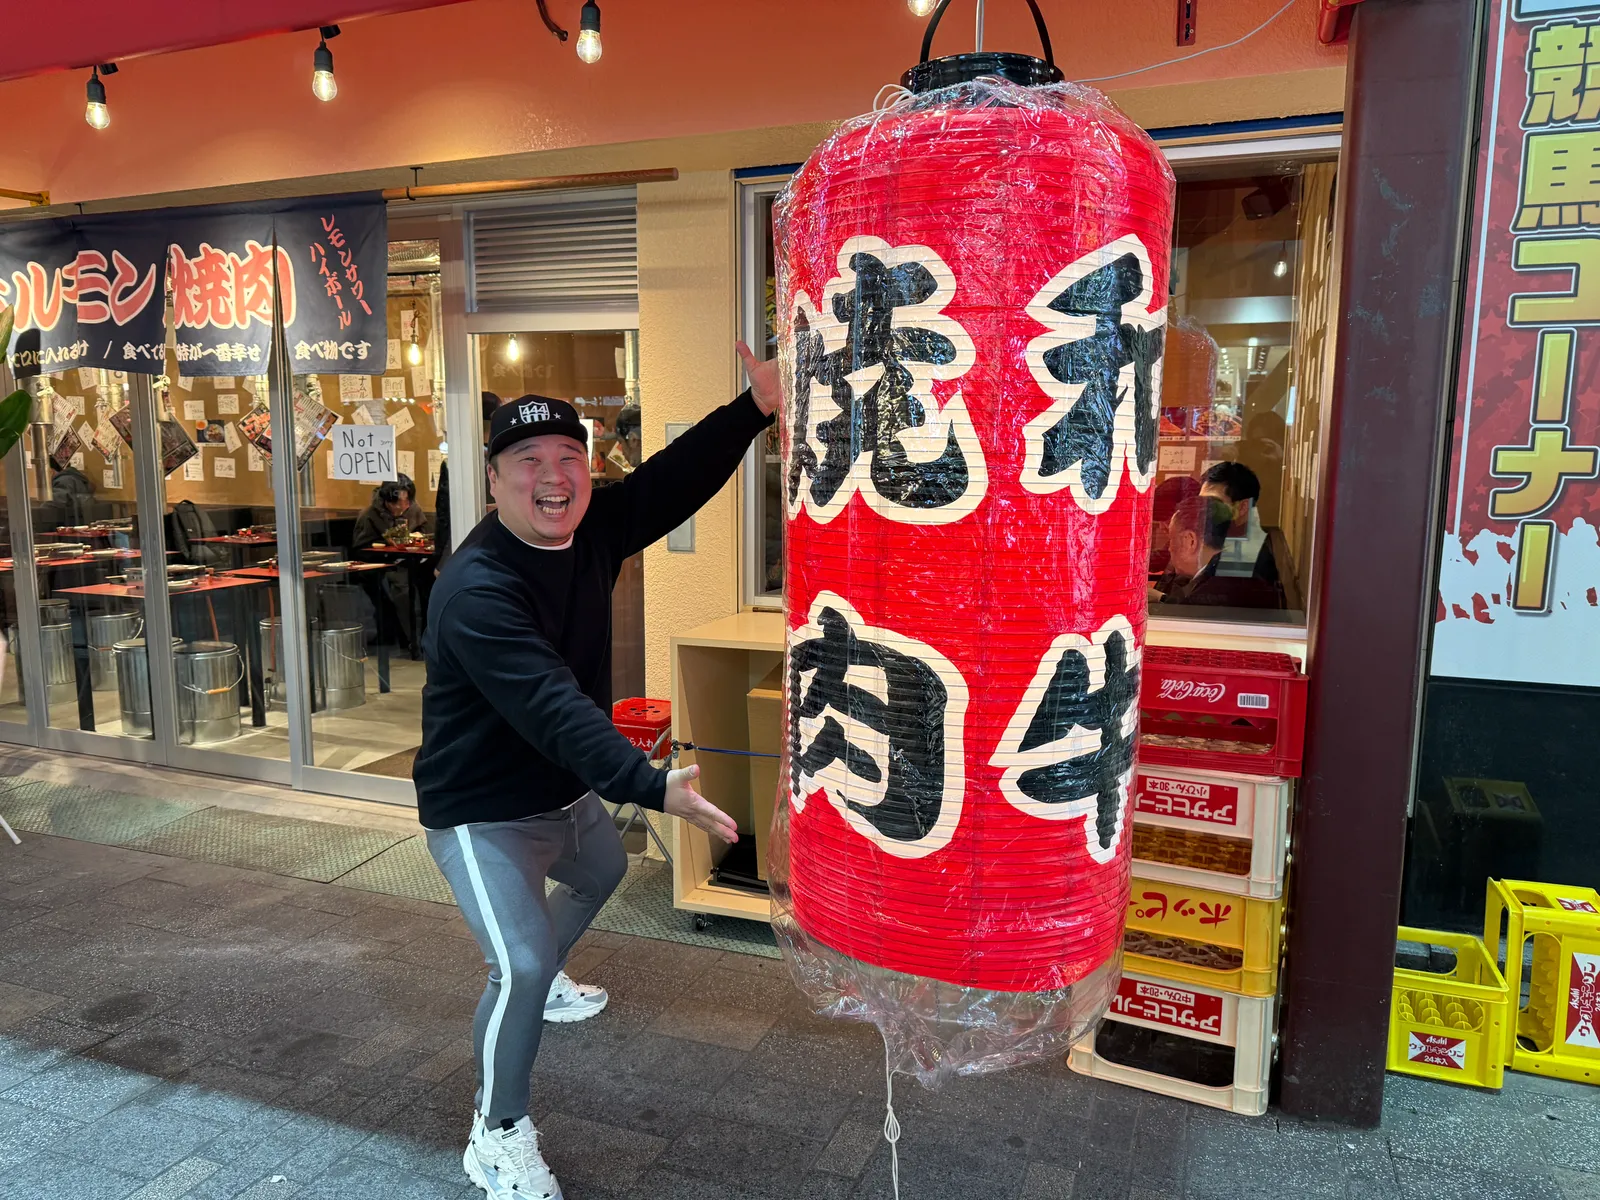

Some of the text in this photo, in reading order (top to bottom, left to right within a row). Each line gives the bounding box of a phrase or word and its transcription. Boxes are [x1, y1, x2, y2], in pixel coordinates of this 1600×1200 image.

[320, 213, 373, 316] レモンサワー
[309, 242, 352, 330] ハイボール
[294, 340, 372, 361] 食べ物です
[522, 404, 547, 416] 444
[342, 429, 374, 449] Not
[339, 449, 391, 475] OPEN
[786, 236, 988, 859] 焼肉
[627, 736, 655, 748] ら入れ
[1129, 891, 1232, 929] ホッピ
[1569, 987, 1580, 1010] Asahi
[1113, 994, 1219, 1032] アサヒビール
[1425, 1035, 1448, 1046] Asahi
[1423, 1055, 1449, 1066] 24本入
